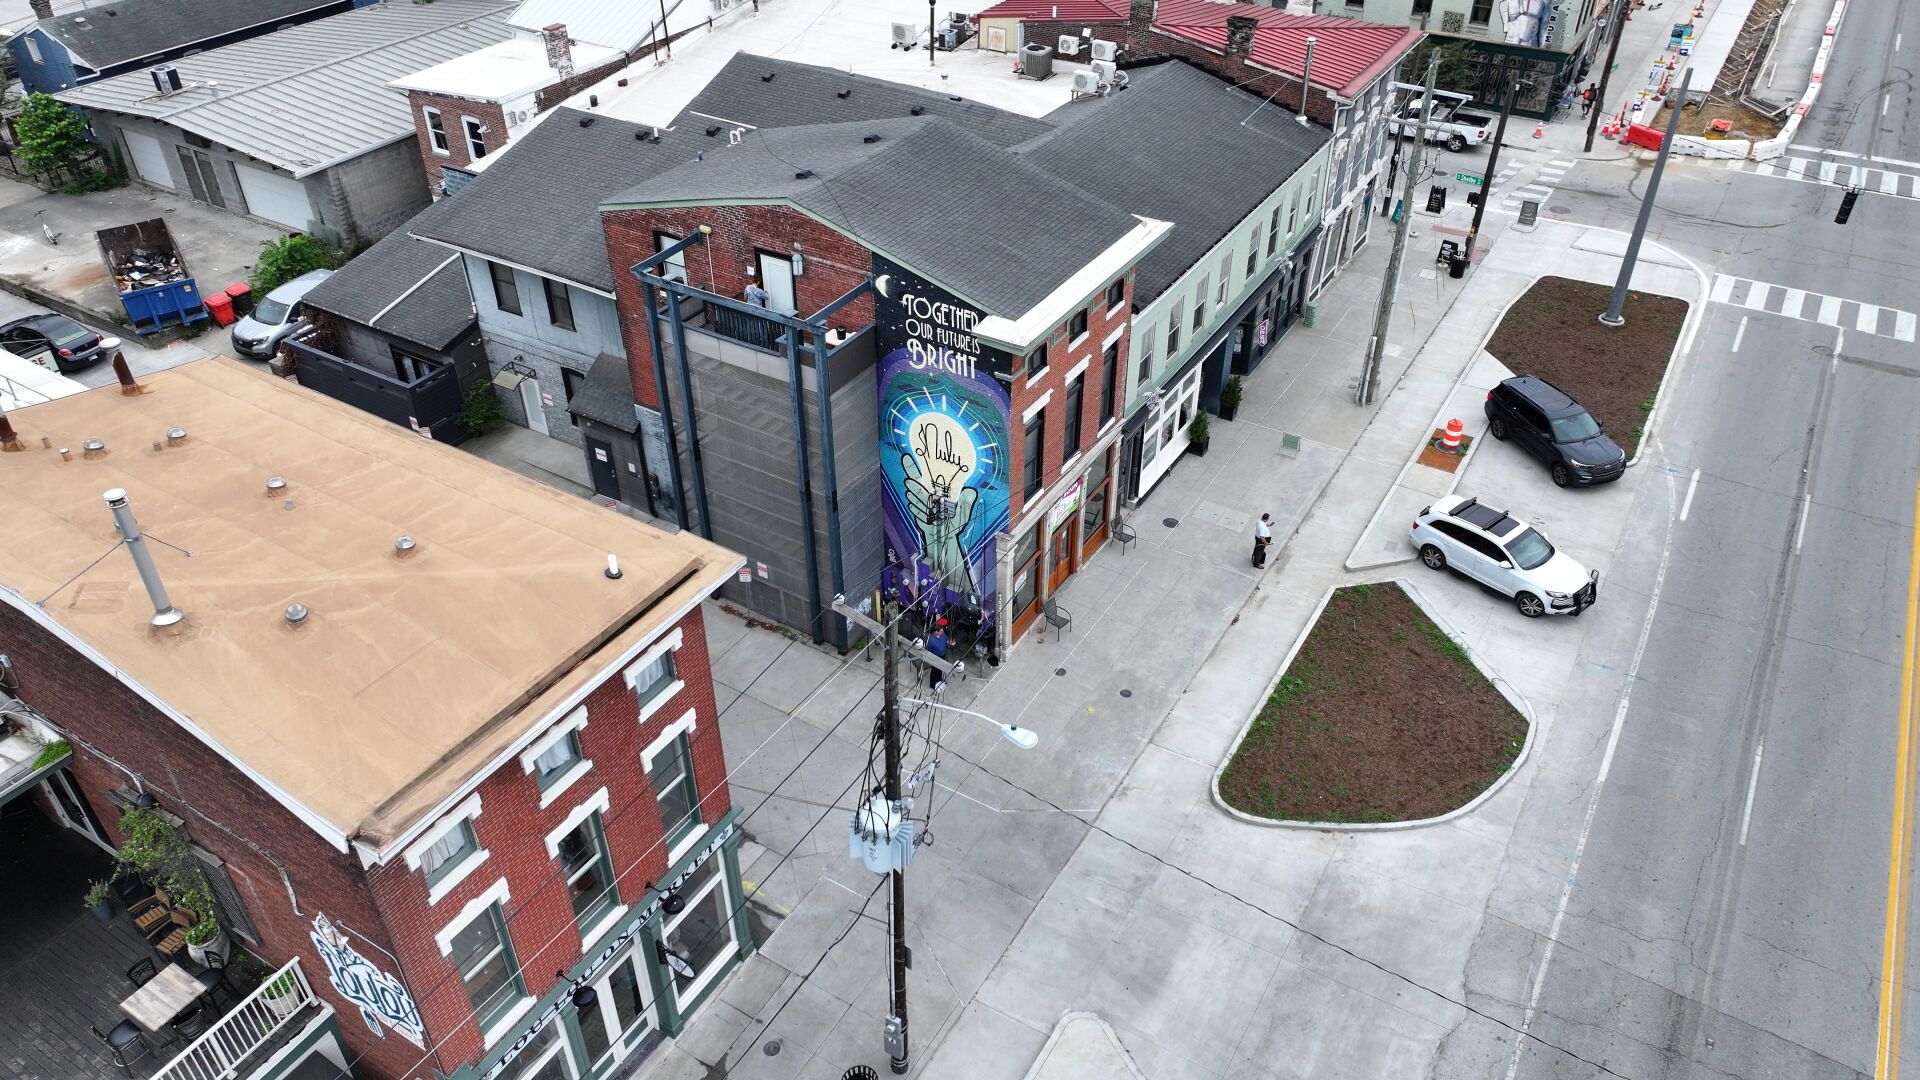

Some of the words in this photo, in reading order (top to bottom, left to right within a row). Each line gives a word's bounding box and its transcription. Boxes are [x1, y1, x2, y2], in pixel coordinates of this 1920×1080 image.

[905, 319, 933, 340] OUR
[936, 328, 971, 352] FUTURE
[907, 338, 978, 379] BRIGHT
[499, 1017, 544, 1067] LOU
[602, 930, 630, 961] ON
